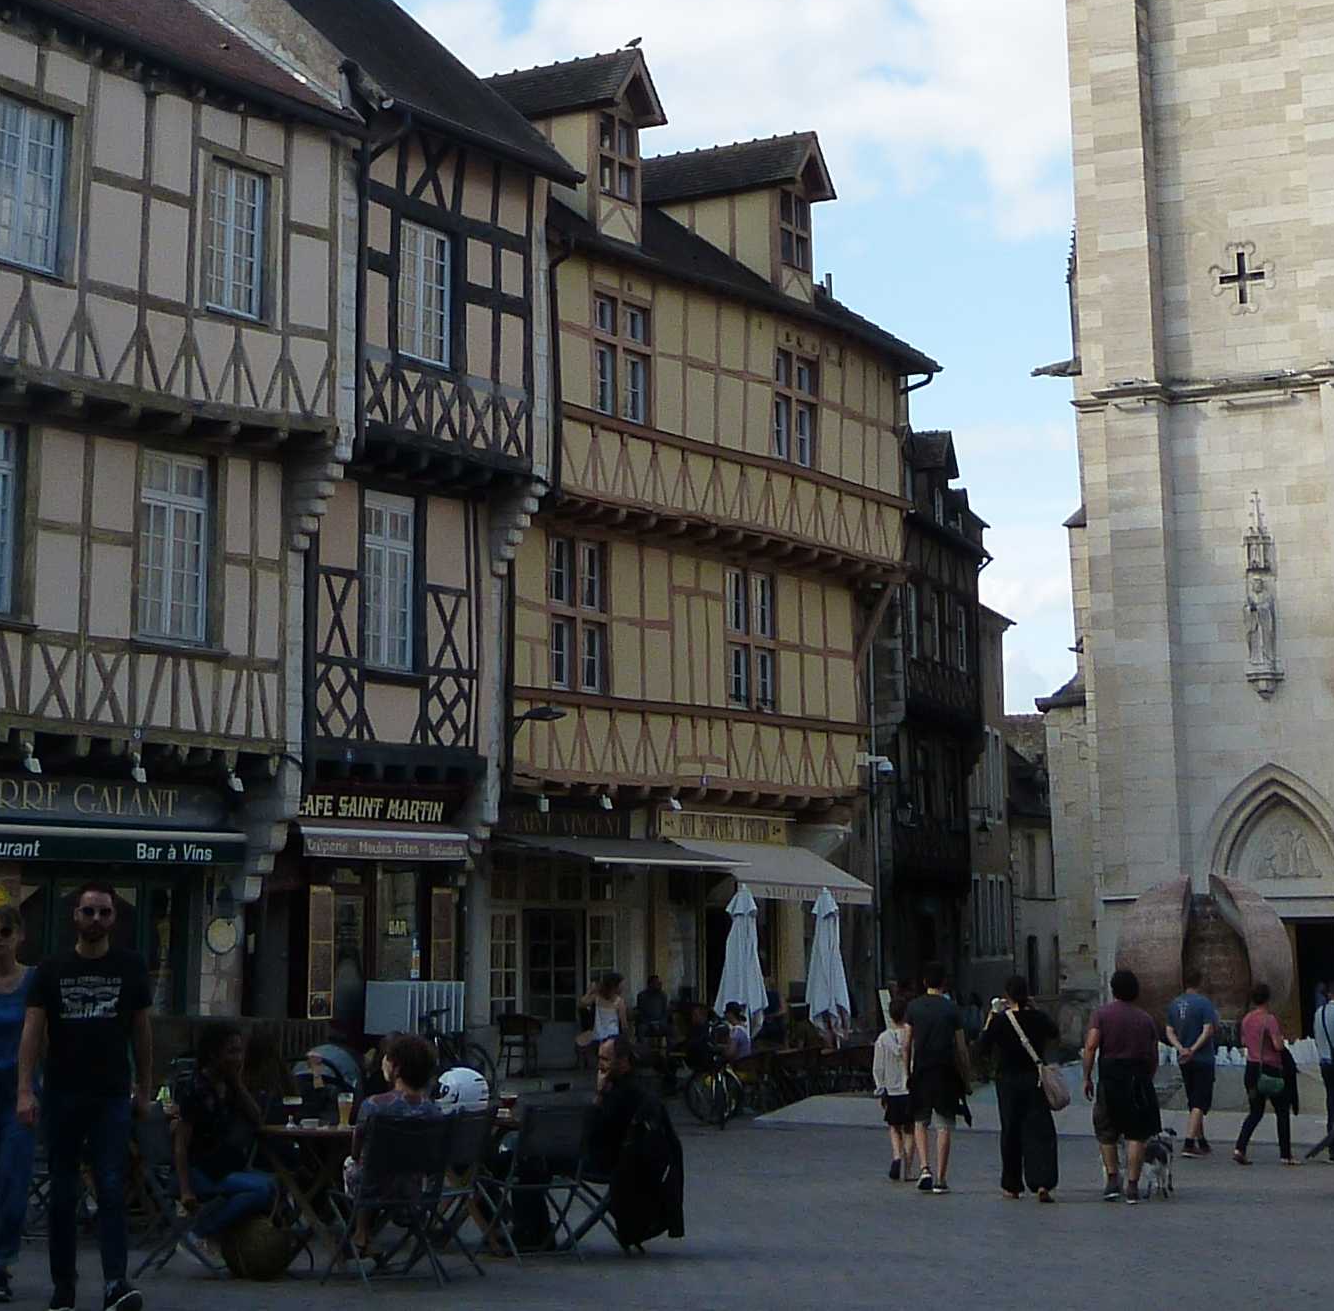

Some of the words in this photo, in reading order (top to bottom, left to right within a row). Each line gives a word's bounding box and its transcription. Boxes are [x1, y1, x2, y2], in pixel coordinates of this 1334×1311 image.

[73, 783, 179, 818] GALANT
[337, 795, 385, 819] SAINT
[386, 798, 445, 823] MARTIN
[136, 842, 162, 861] Bar
[167, 842, 178, 861] à
[183, 843, 213, 862] Vins
[388, 920, 408, 935] BAR
